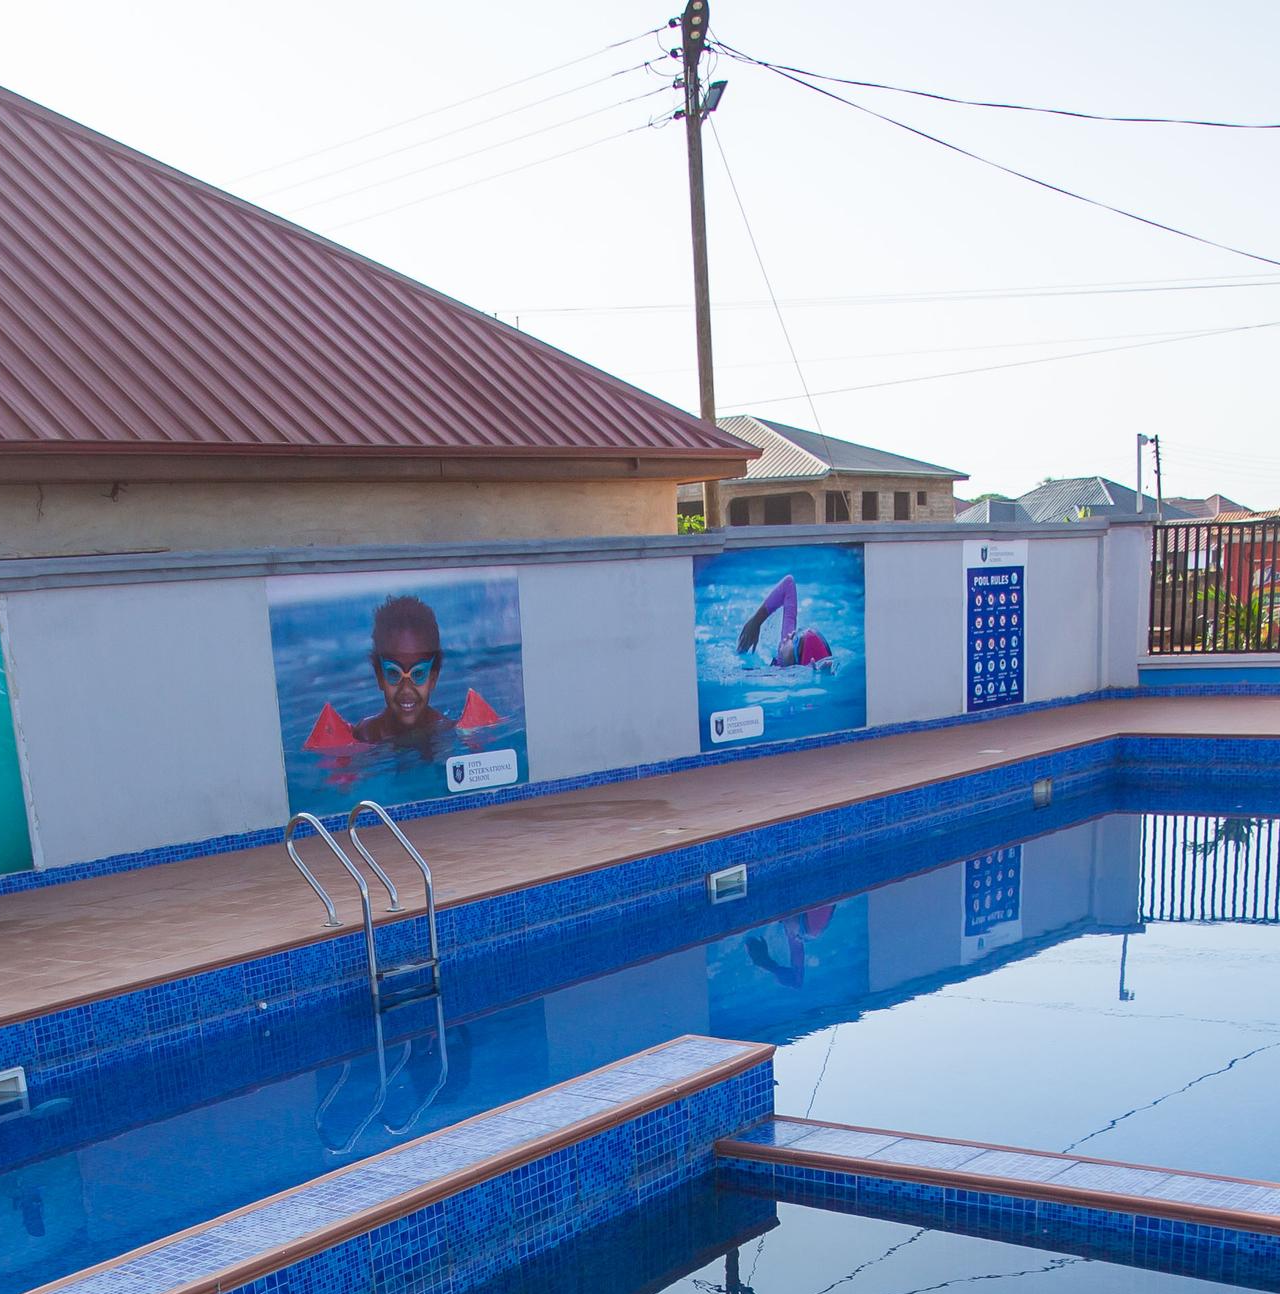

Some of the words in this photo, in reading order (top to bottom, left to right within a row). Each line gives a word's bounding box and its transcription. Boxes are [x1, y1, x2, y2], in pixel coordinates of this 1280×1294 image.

[973, 576, 990, 586] POOL
[990, 574, 1009, 585] RULES
[468, 763, 512, 775] INTERNATIONAL
[468, 774, 490, 782] SCHOOL
